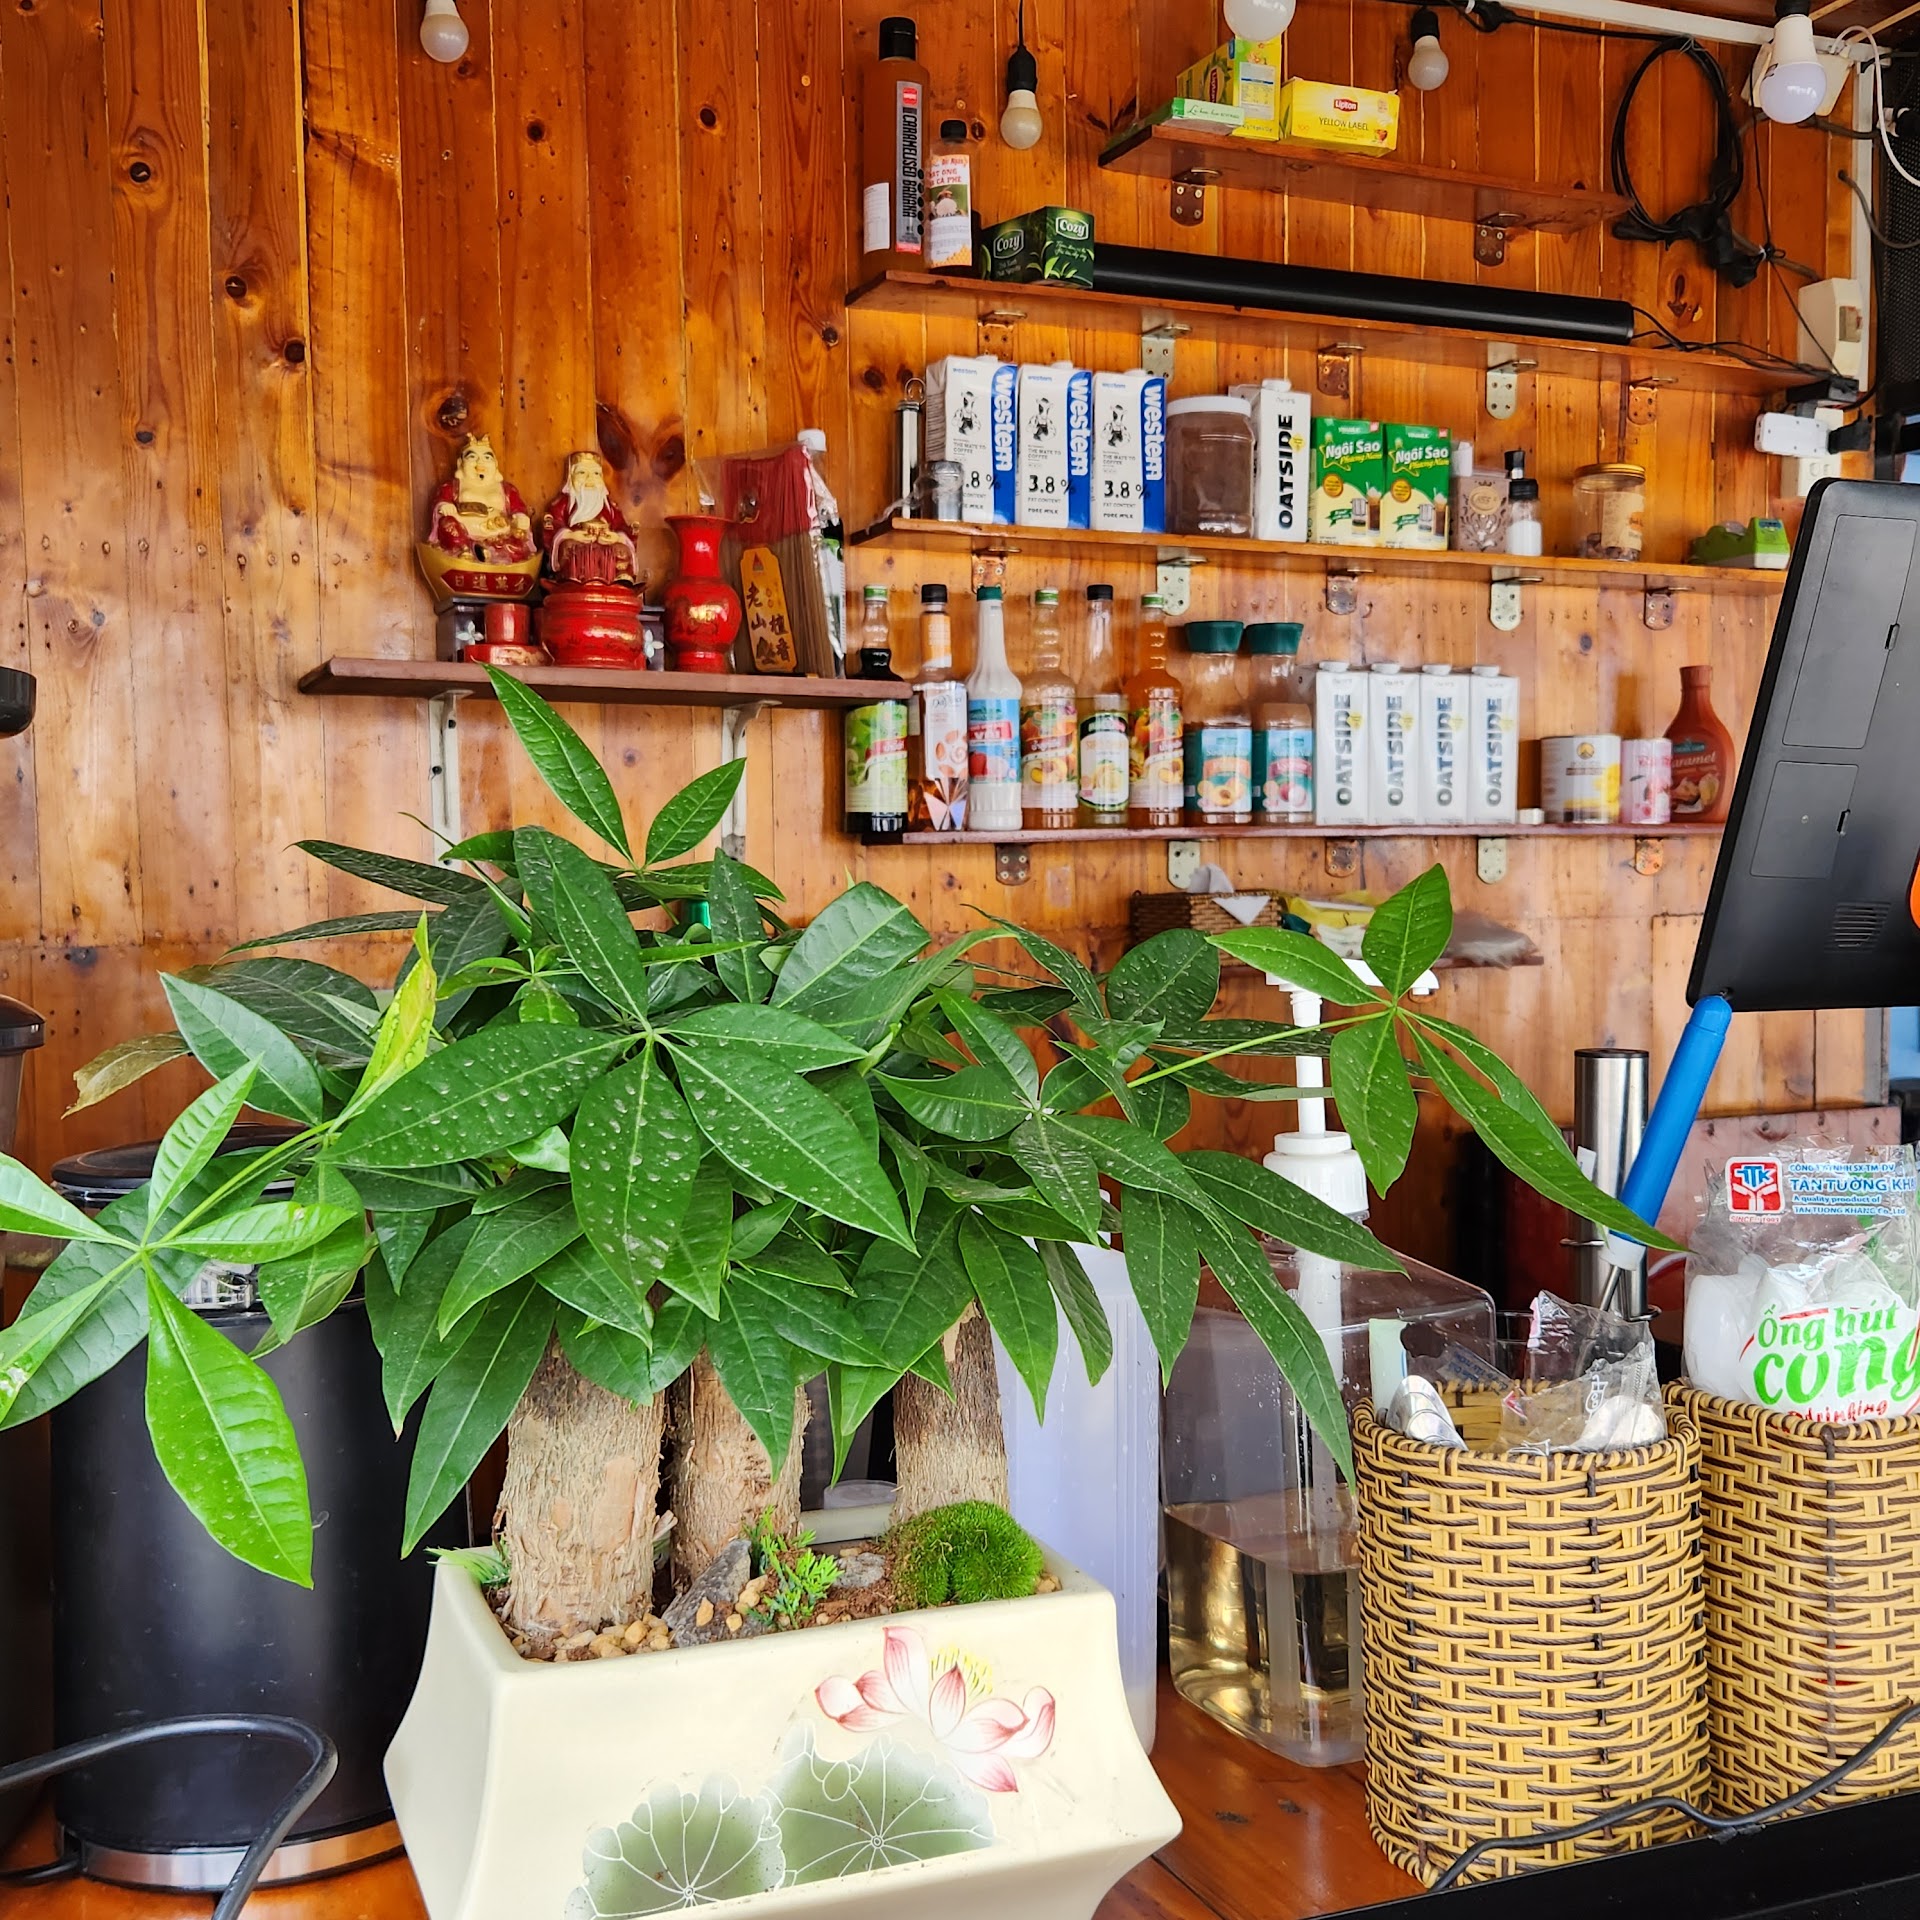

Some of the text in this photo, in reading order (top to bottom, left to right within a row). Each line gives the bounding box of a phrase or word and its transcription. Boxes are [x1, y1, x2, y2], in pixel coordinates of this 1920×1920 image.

[1335, 100, 1357, 111] Lipton
[1319, 117, 1369, 131] YELLOW LABEL
[902, 114, 918, 179] CARAMELISED
[902, 179, 918, 218] BANANA
[1060, 220, 1085, 237] Cozy
[996, 235, 1020, 252] Cozy
[994, 374, 1017, 471] western
[1070, 379, 1091, 476] western
[1143, 385, 1165, 481] western
[1325, 441, 1380, 459] Ngôi Sao
[1395, 447, 1449, 464] Ngôi Sao
[1278, 414, 1294, 531] OATSIDE
[1029, 475, 1055, 494] 3.8
[1104, 480, 1130, 499] 3.8
[1334, 694, 1352, 806] OATSIDE
[1387, 696, 1404, 807] OATSIDE
[1437, 697, 1453, 807] OATSIDE
[1486, 698, 1503, 807] OATSIDE
[1672, 751, 1716, 768] aramel
[1737, 1165, 1771, 1187] TTK
[1790, 1163, 1814, 1171] CÔNG
[1790, 1176, 1822, 1191] TÂN
[1801, 1195, 1830, 1203] quality
[1758, 1299, 1900, 1351] Ống hút
